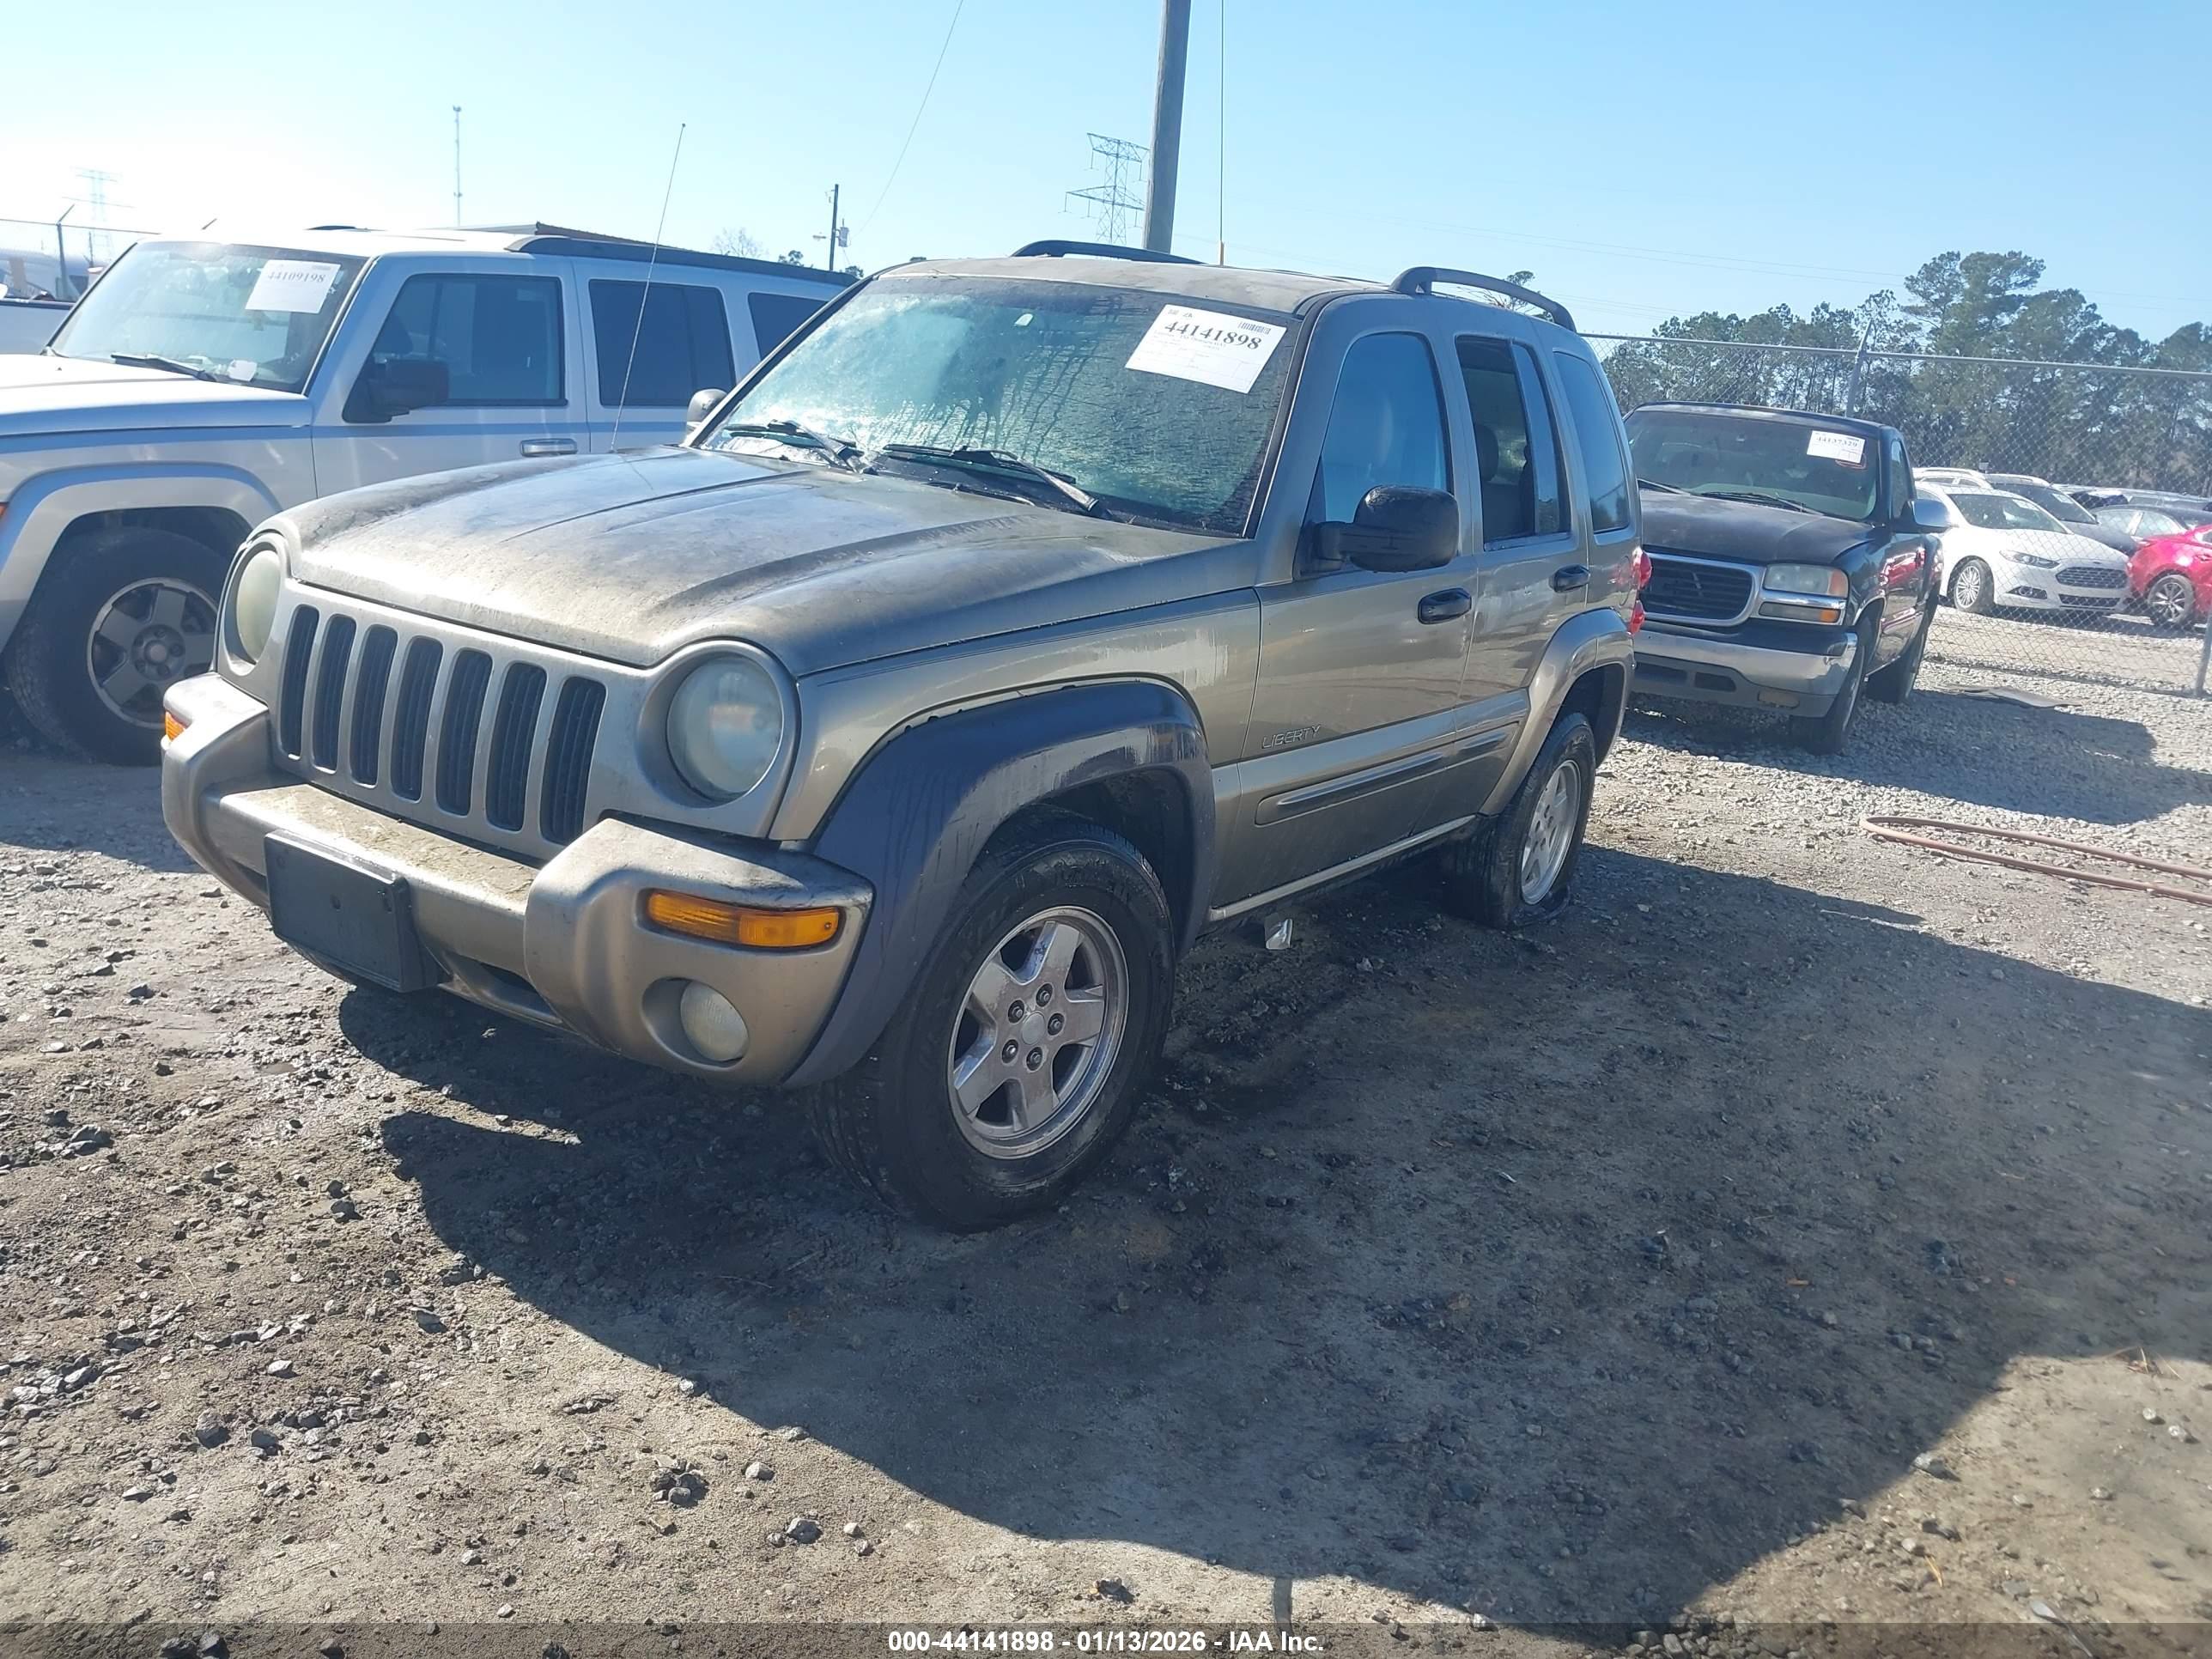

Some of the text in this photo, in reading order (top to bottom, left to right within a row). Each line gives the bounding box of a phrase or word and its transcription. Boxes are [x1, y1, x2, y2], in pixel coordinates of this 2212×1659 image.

[267, 270, 326, 283] 44109198
[1164, 320, 1262, 350] 44141898
[1262, 724, 1322, 750] LIBERTY
